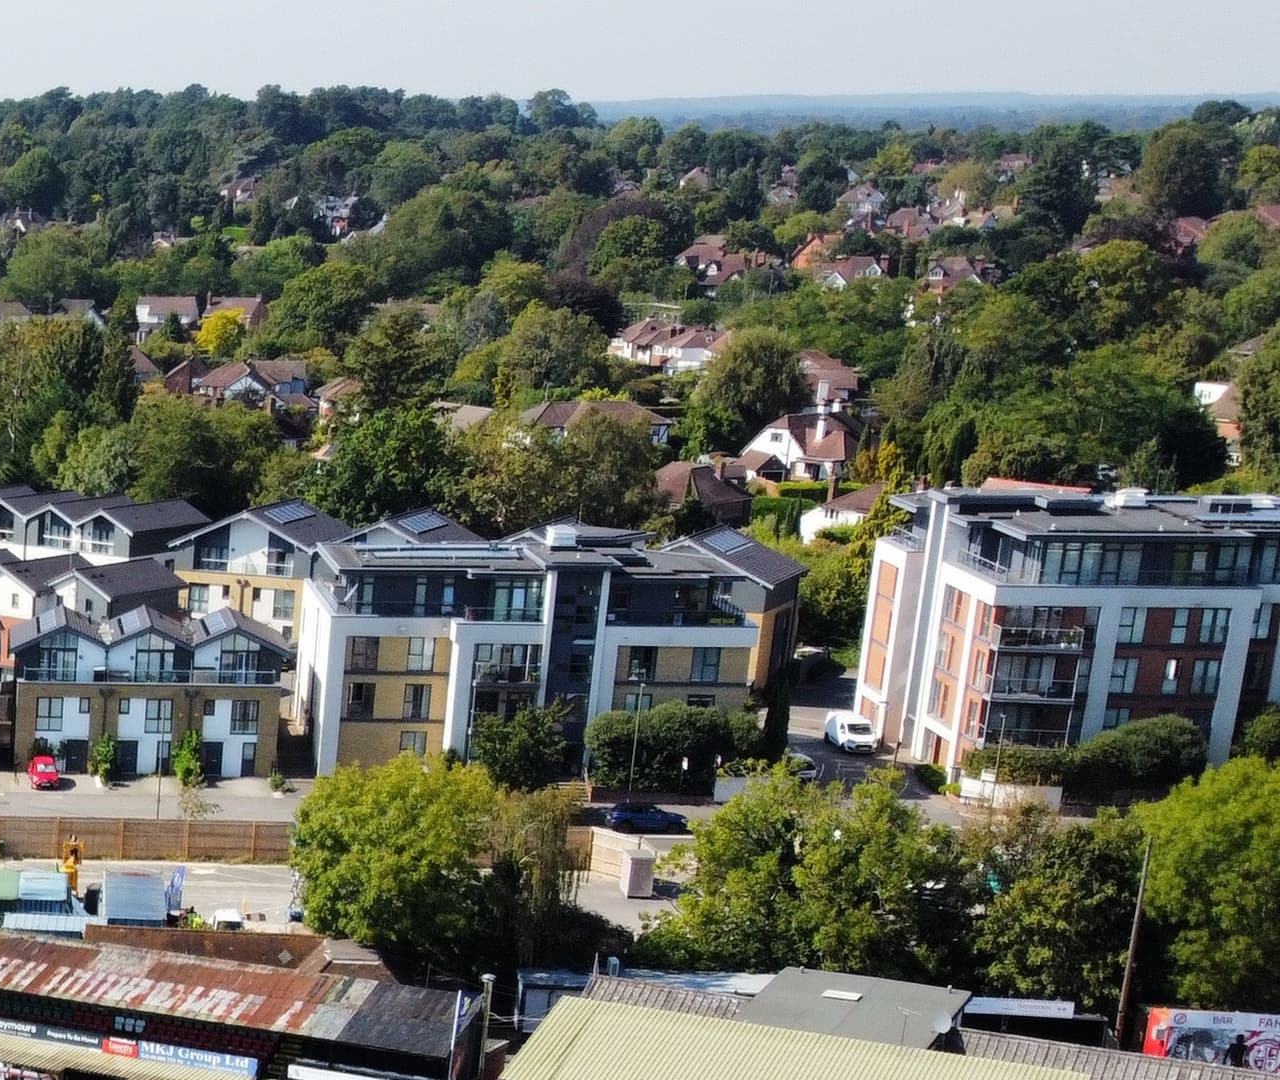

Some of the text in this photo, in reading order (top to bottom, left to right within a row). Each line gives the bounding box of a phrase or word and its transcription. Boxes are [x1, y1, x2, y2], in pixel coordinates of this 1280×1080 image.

[1212, 1016, 1233, 1025] BAR
[141, 1041, 175, 1056] MKJ
[177, 1046, 221, 1066] Group
[224, 1054, 249, 1068] Ltd
